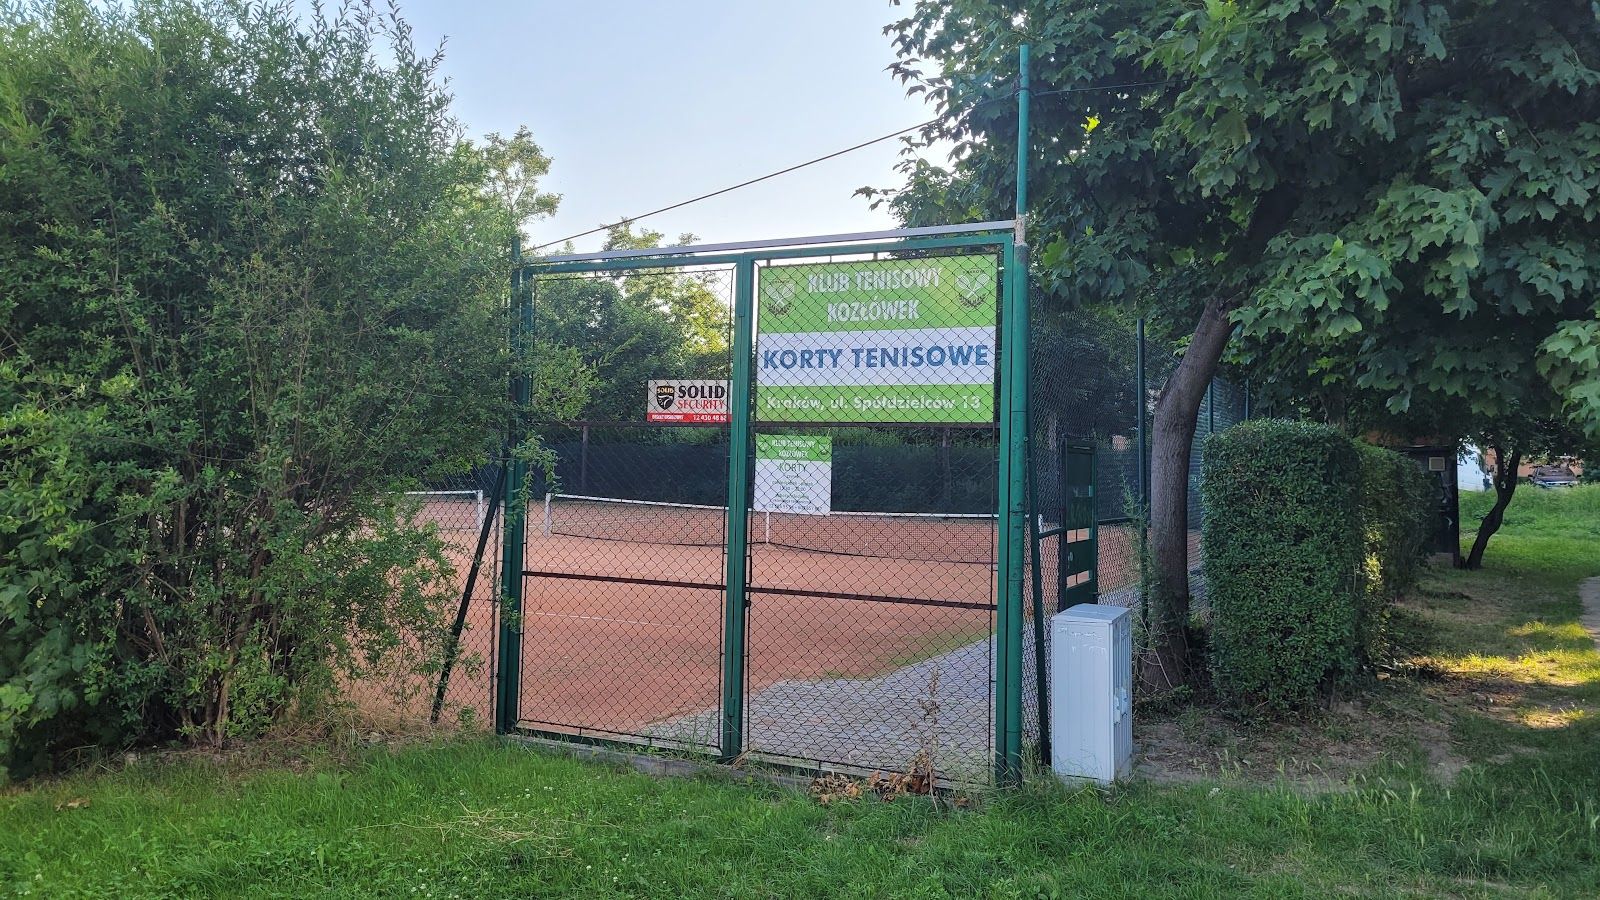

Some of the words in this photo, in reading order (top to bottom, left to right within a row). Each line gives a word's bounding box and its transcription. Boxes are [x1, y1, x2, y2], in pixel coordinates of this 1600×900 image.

[808, 272, 850, 293] KLUB
[855, 267, 943, 292] TENISOWY
[827, 296, 920, 322] KOZŁÓWEK
[763, 348, 844, 370] KORTY
[851, 344, 989, 369] TENISOWE
[678, 385, 726, 399] SOLID
[677, 399, 725, 410] SECURITY
[767, 396, 825, 411] Kraków,
[831, 396, 848, 409] ul.
[854, 395, 956, 412] Spółdzielców
[962, 395, 981, 409] 13
[779, 462, 808, 472] KORTY
